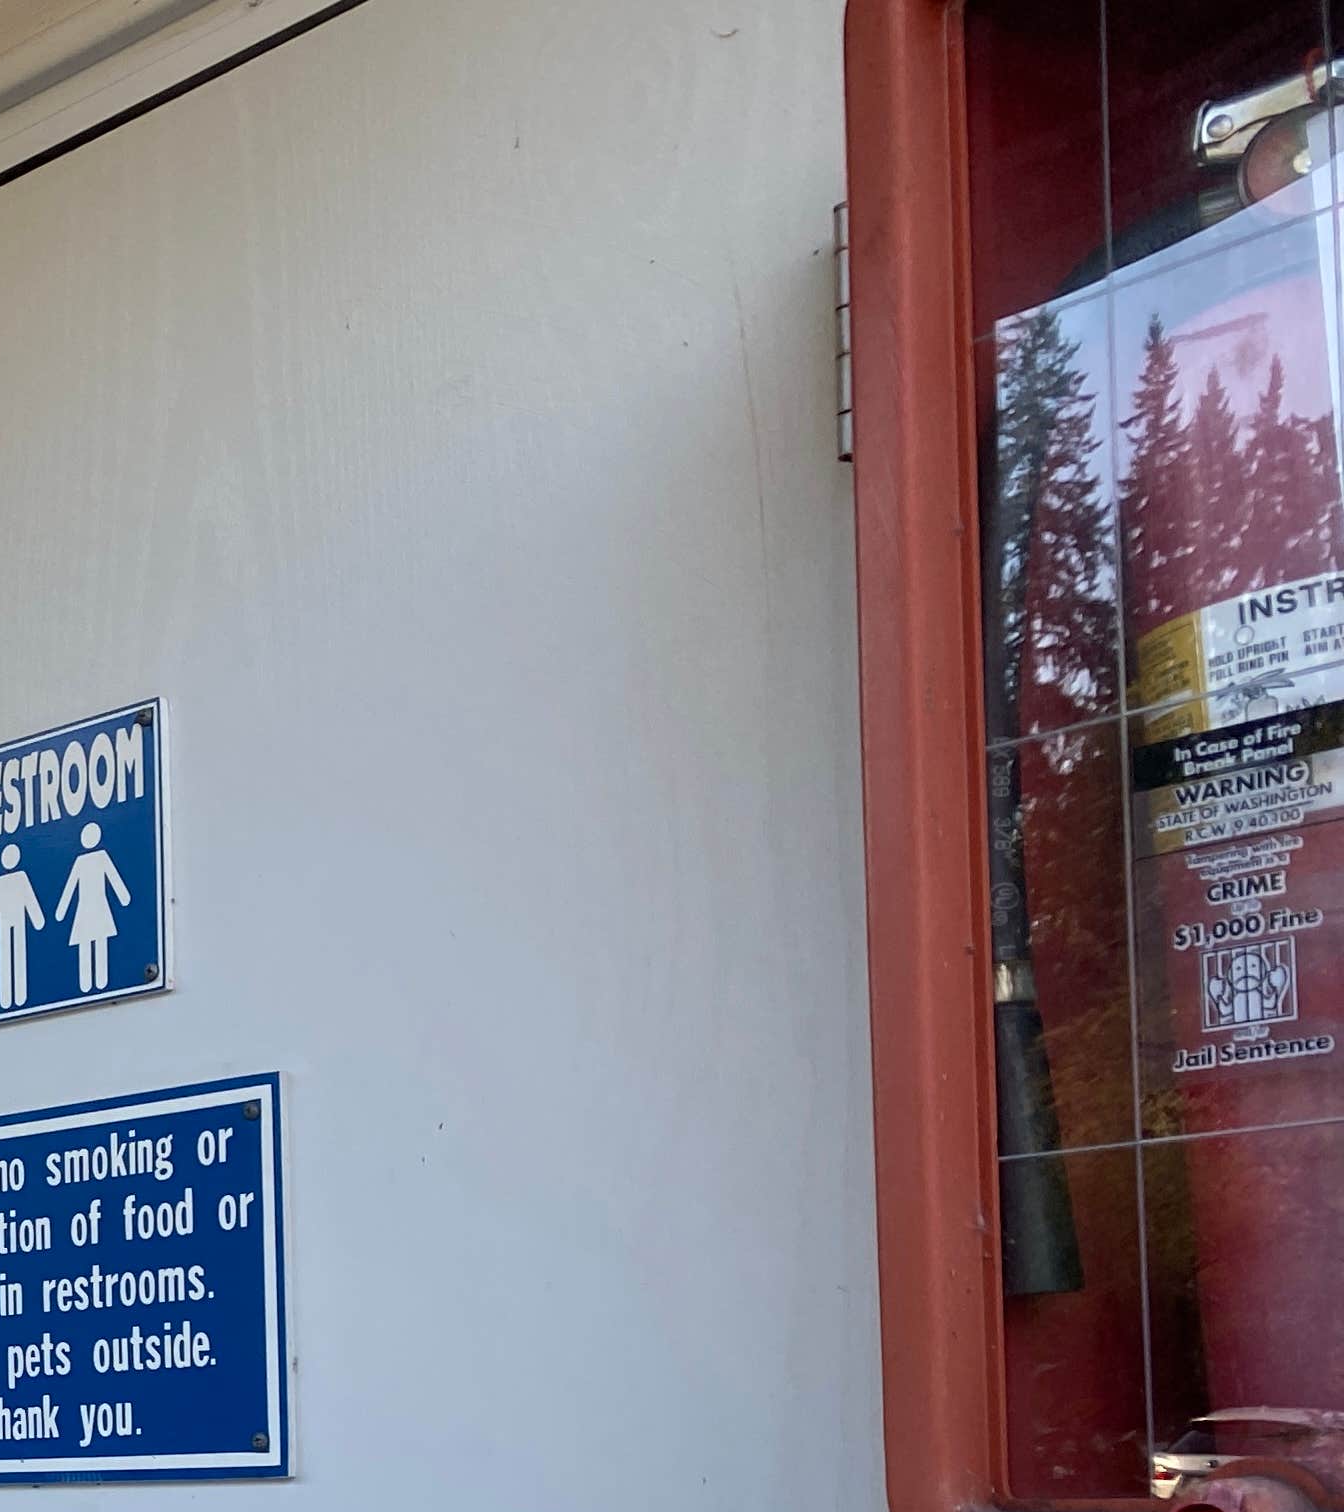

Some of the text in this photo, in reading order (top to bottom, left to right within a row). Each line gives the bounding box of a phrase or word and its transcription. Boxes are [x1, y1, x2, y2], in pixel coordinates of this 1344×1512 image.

[1237, 636, 1287, 660] UPRIGHT
[1269, 650, 1289, 665] PIN
[1175, 722, 1301, 762] In Case of Fire
[1184, 738, 1294, 776] Break Panel
[1175, 762, 1307, 806] WARNING
[1159, 782, 1333, 829] STATE OF WASHINGTON
[1207, 872, 1283, 902] CRIME
[1175, 909, 1319, 946] $1,000 Fine
[1175, 1036, 1331, 1069] Jail Sentence
[46, 1129, 174, 1187] smoking
[197, 1127, 233, 1166] or
[70, 1198, 102, 1246] of
[123, 1187, 194, 1241] food
[218, 1192, 254, 1231] or
[0, 1273, 23, 1317] in
[42, 1264, 215, 1313] restrooms.
[8, 1332, 71, 1389] pets
[93, 1320, 216, 1374] outside.
[79, 1402, 142, 1447] you.
